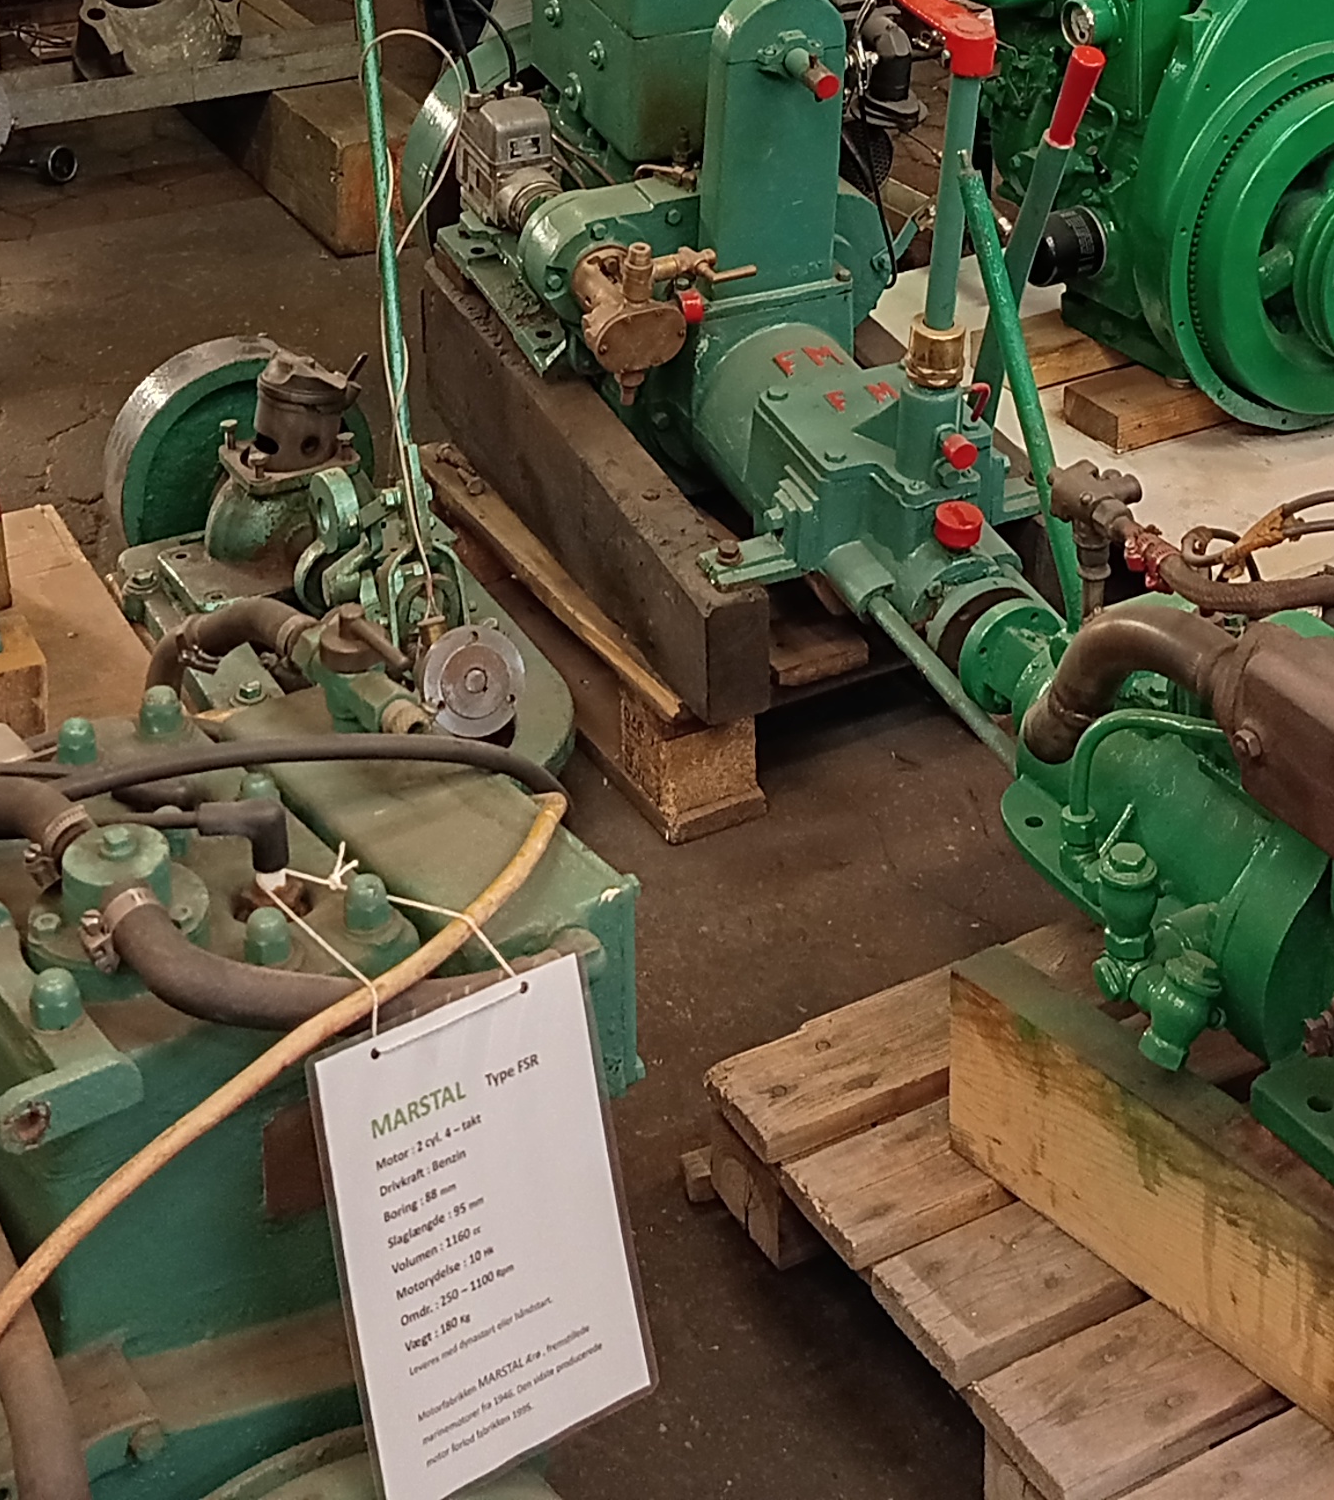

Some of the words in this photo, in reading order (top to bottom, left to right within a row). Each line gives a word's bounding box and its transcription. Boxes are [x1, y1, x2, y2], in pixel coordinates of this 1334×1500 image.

[370, 1081, 466, 1140] MARSTAL
[485, 1066, 516, 1088] Type
[517, 1053, 540, 1074] FSR
[375, 1149, 410, 1171] Motor
[417, 1140, 424, 1152] 2
[461, 1113, 482, 1131] takt
[379, 1168, 426, 1197] Drivkraft
[431, 1149, 467, 1172] Benzin
[383, 1199, 418, 1223] Boring
[425, 1188, 438, 1203] 88
[439, 1183, 457, 1196] mm
[387, 1213, 446, 1249] Slaglængde
[453, 1202, 467, 1217] 95
[468, 1197, 485, 1210] mm
[391, 1245, 438, 1274] Volumen
[445, 1228, 471, 1248] 1160
[396, 1260, 462, 1301] Motorydelse
[469, 1250, 483, 1264] 10
[400, 1305, 435, 1327] Omdr.
[440, 1288, 460, 1308] 250
[470, 1271, 495, 1292] 1100
[404, 1332, 433, 1352] Vægt
[440, 1316, 459, 1336] 180
[477, 1358, 525, 1390] MARSTAL
[425, 1448, 450, 1468] motor
